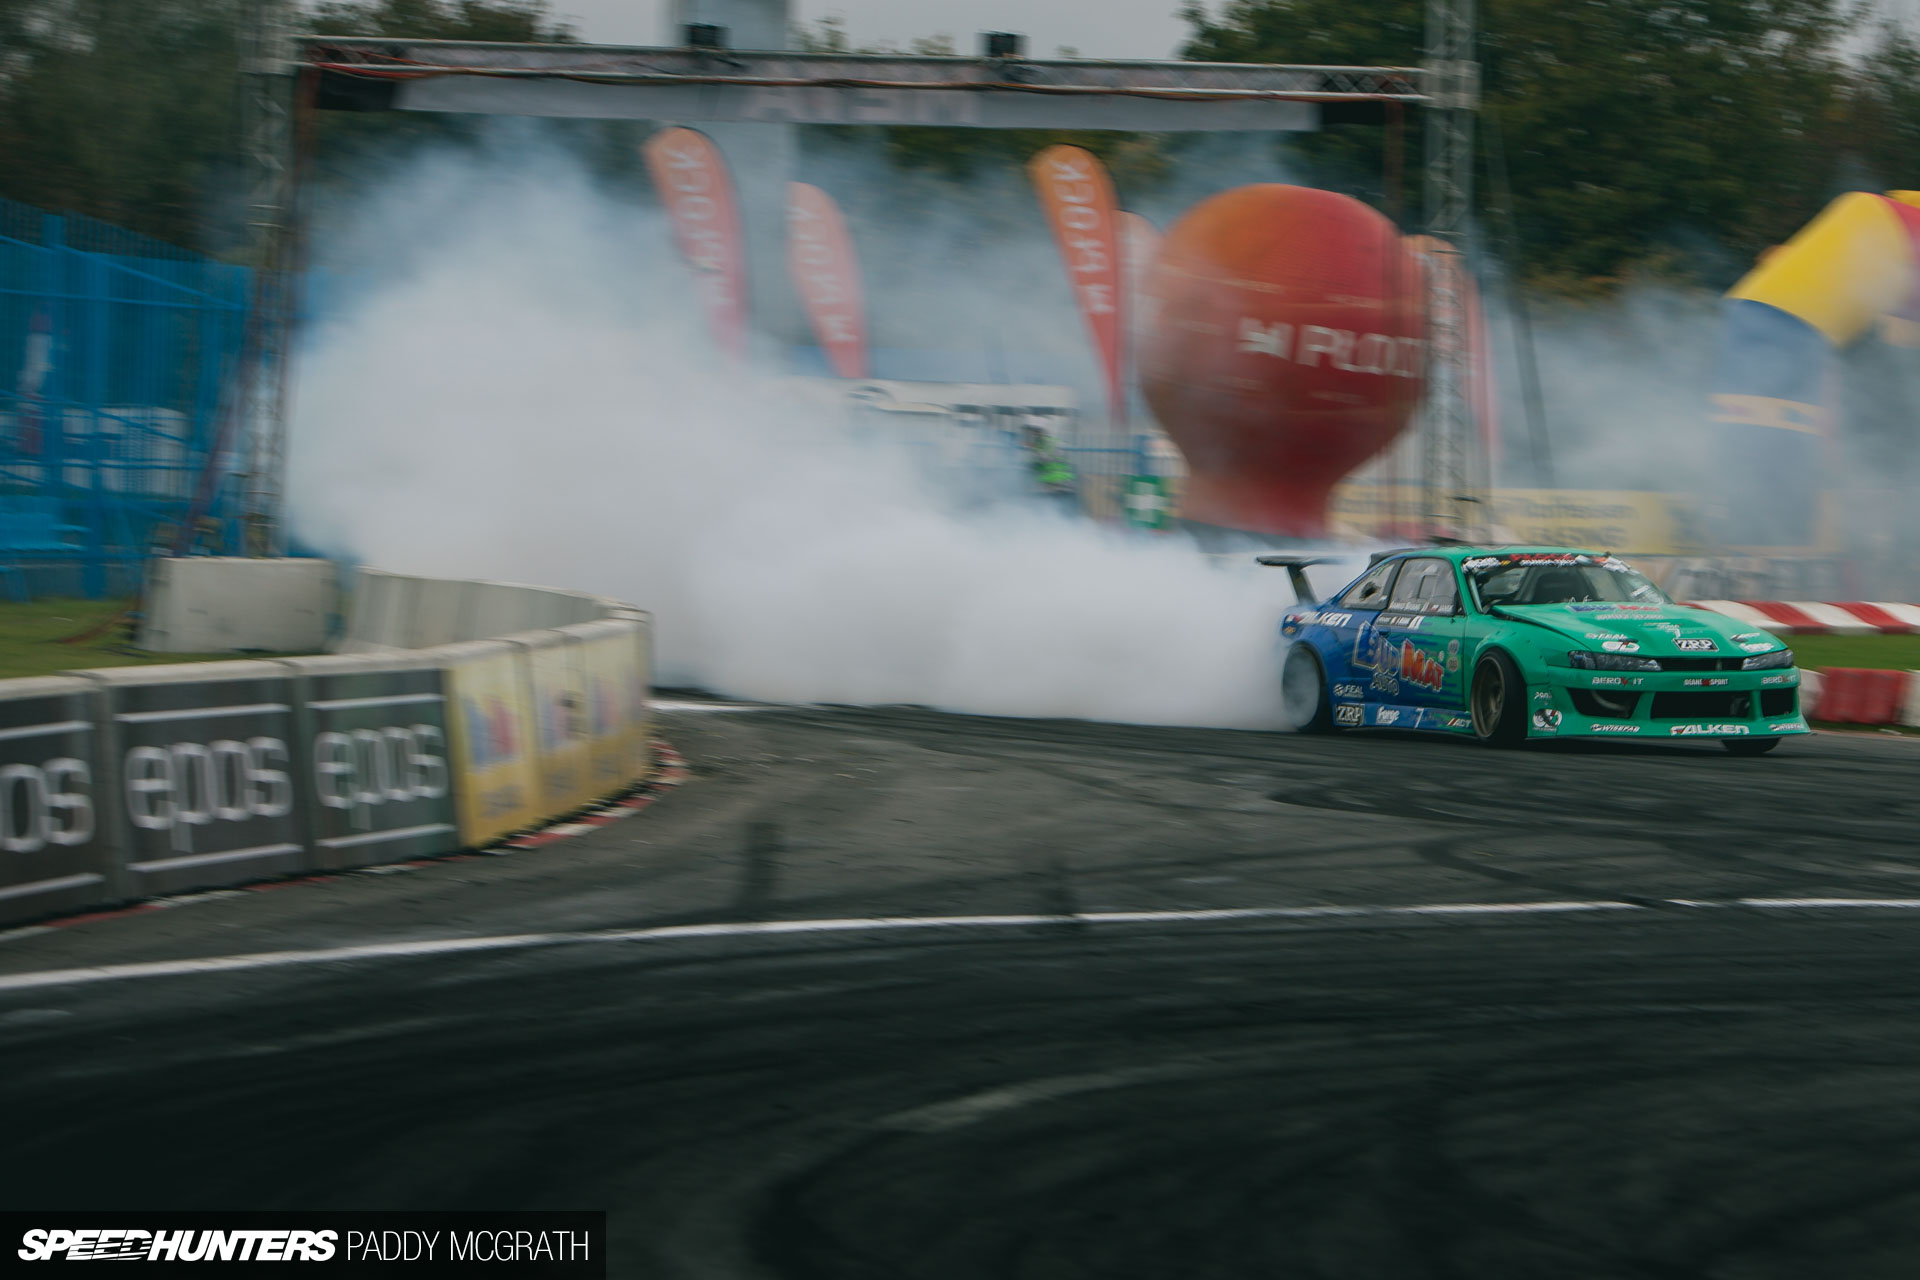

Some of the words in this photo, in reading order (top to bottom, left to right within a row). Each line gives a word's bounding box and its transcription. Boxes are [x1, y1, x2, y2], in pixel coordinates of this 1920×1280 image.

[313, 723, 448, 831] epos
[1670, 724, 1750, 736] FALKEN
[124, 735, 293, 852] epos
